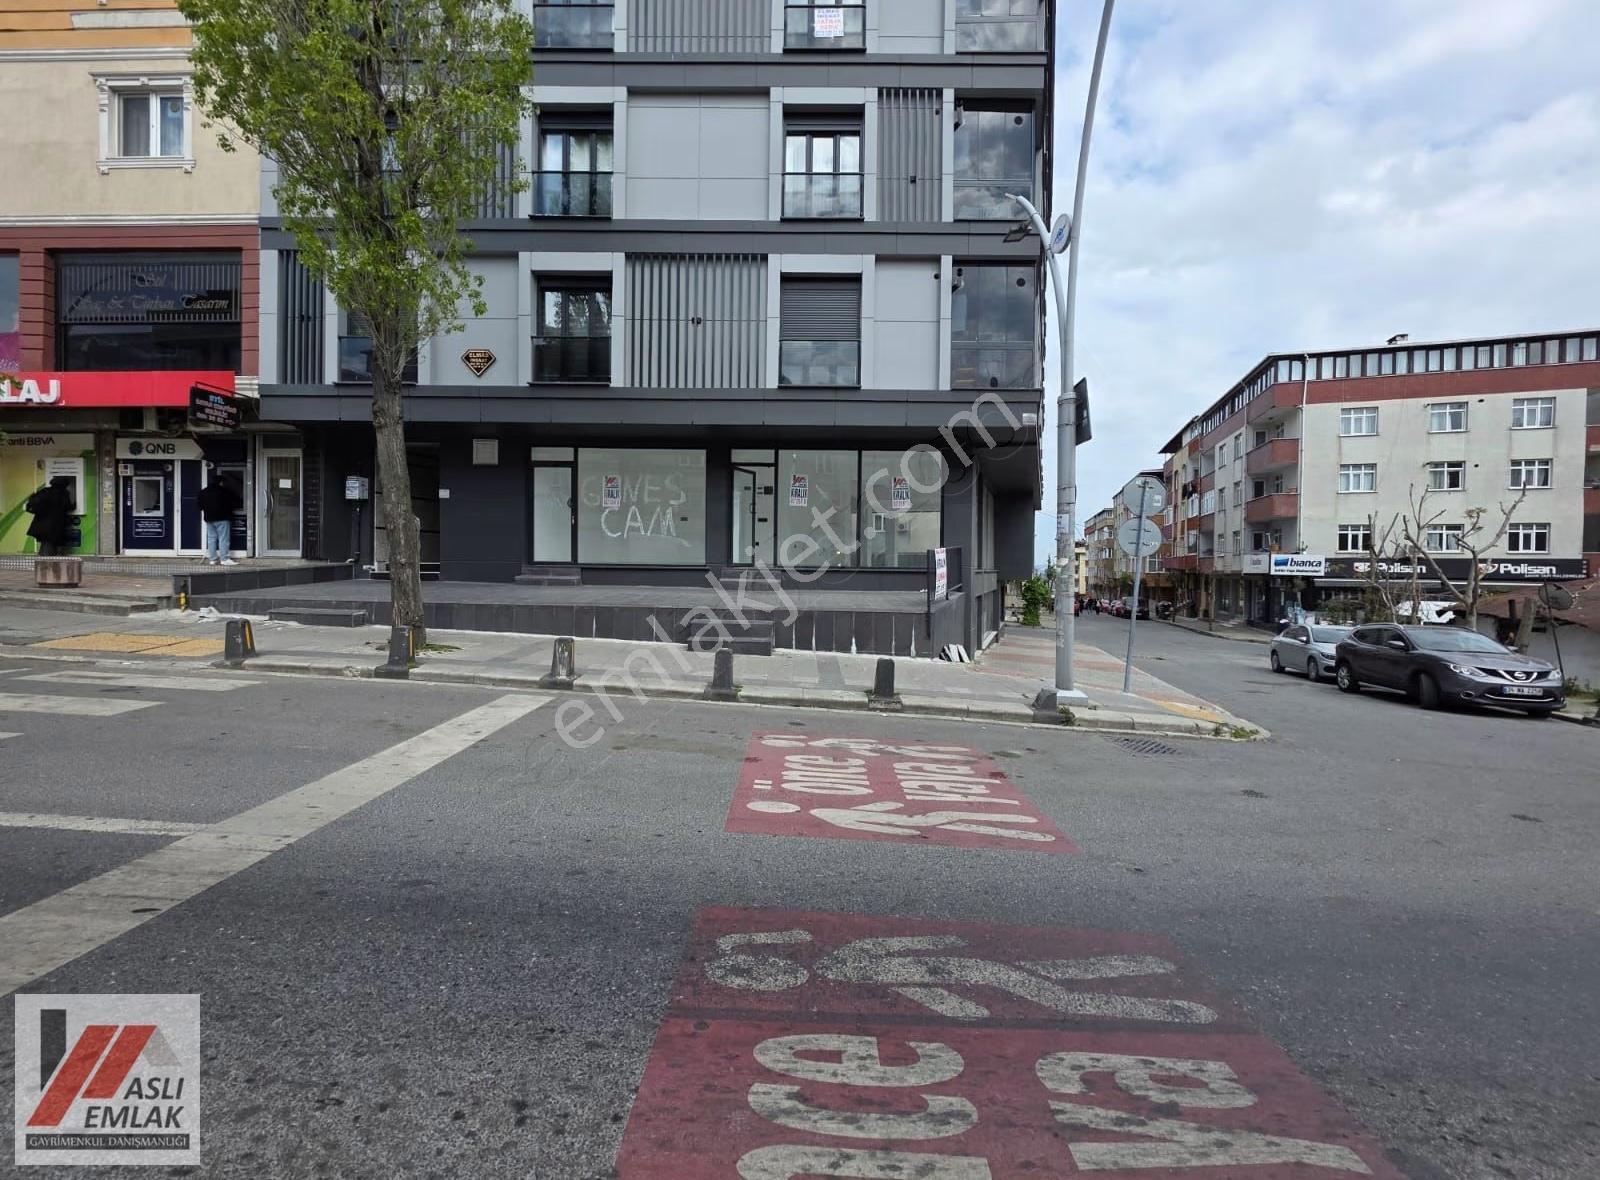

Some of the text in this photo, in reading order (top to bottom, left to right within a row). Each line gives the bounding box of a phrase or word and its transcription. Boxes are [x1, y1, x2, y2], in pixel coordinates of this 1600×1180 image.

[27, 437, 56, 446] BBVA
[145, 443, 176, 455] QNB
[601, 505, 677, 539] CAM
[1289, 557, 1322, 568] bianca
[1499, 563, 1557, 575] Polisan
